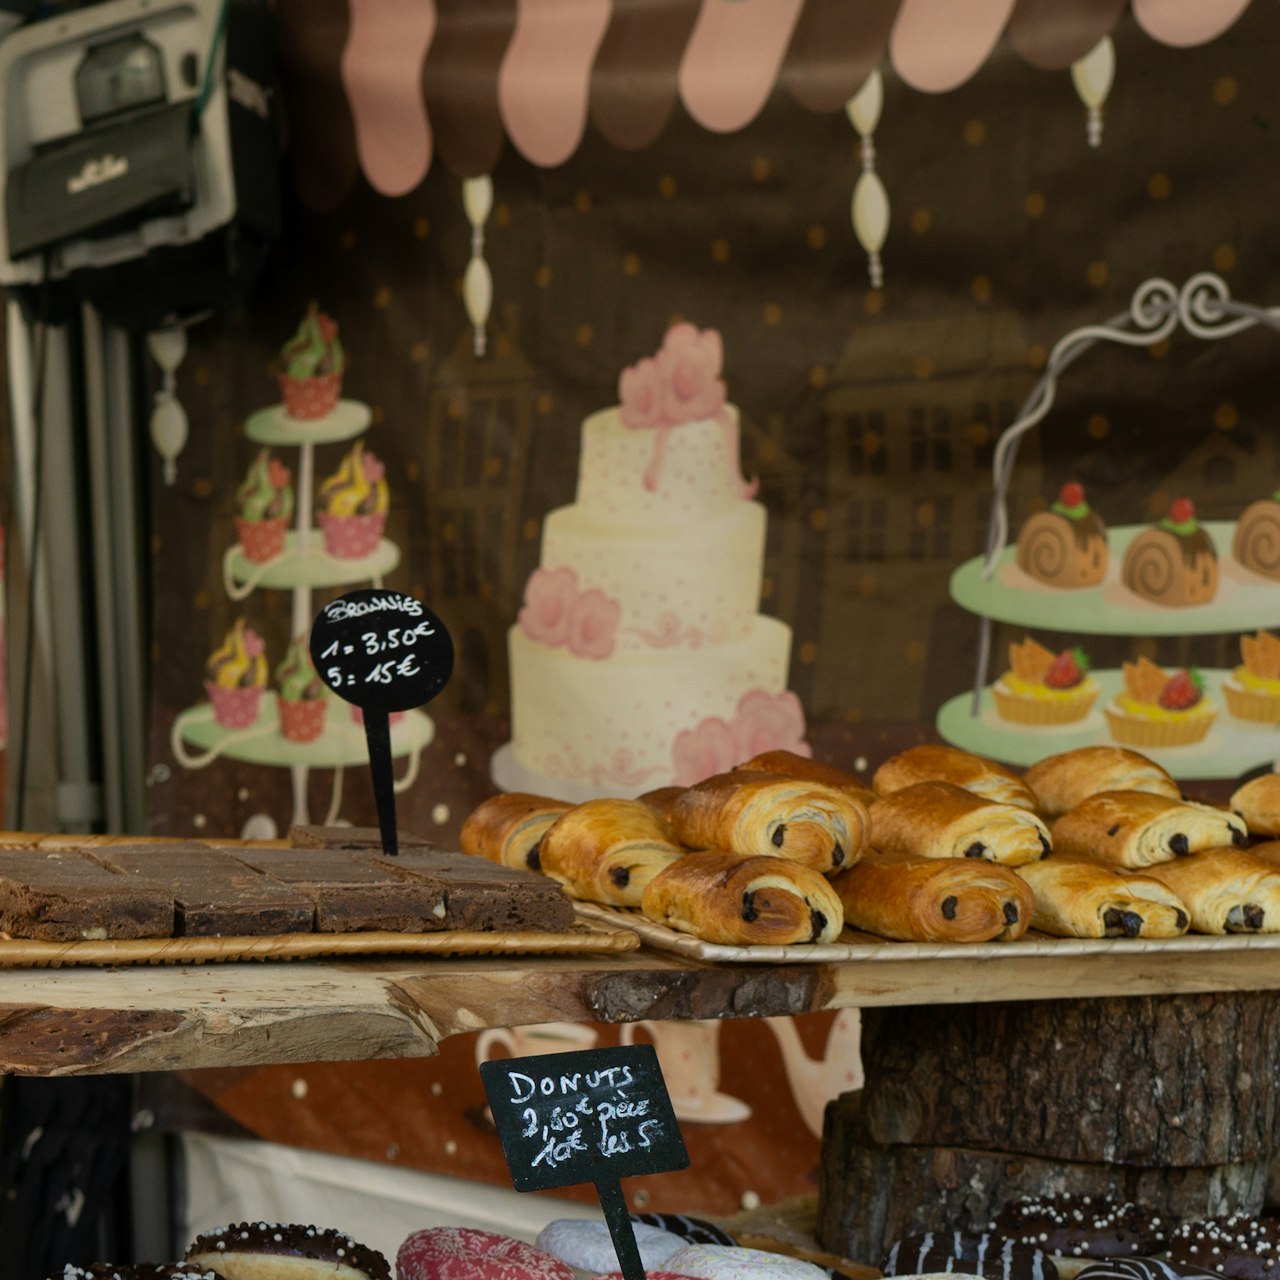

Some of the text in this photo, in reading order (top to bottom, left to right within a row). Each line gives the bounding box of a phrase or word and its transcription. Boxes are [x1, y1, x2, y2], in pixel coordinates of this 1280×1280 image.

[361, 621, 436, 655] 3,50€
[364, 653, 421, 685] 15€
[507, 1065, 635, 1105] DONUTS
